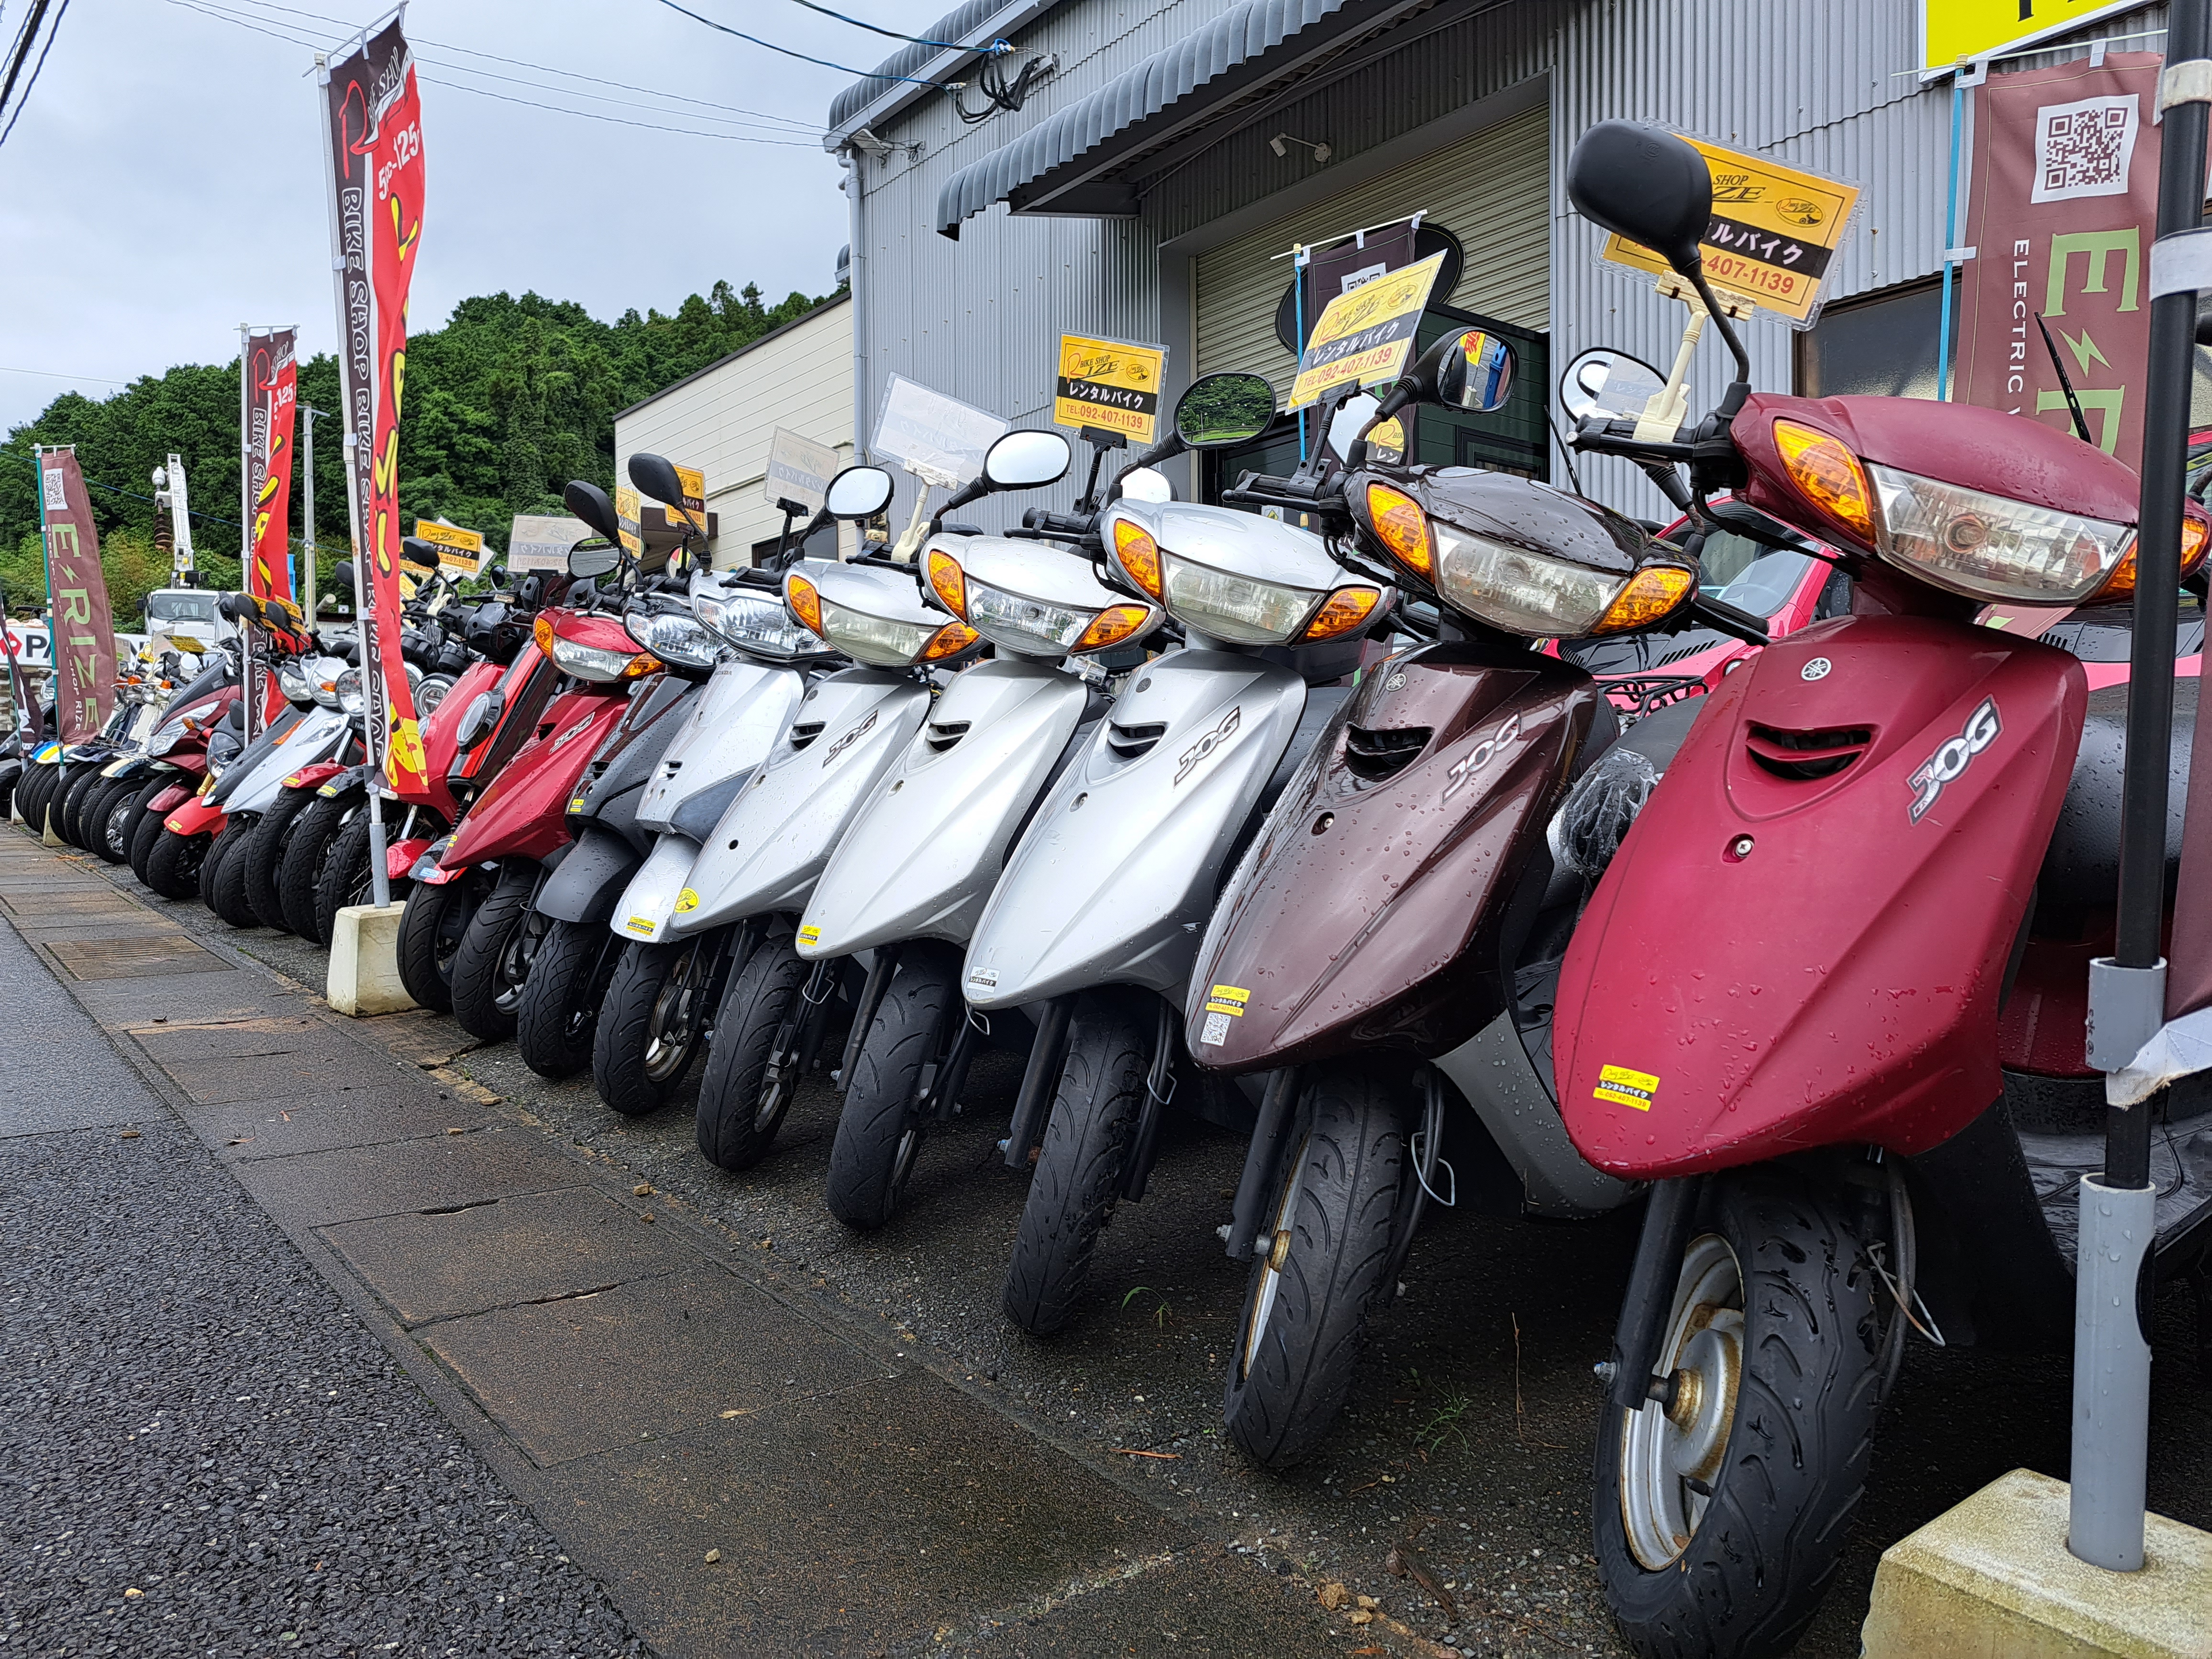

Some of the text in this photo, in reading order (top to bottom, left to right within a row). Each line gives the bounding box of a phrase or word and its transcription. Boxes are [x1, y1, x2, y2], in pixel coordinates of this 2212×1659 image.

[379, 46, 401, 97] SHOP
[1712, 186, 1767, 200] ZE
[1713, 175, 1749, 186] SHOP
[342, 187, 364, 274] BIKE
[1709, 221, 1803, 265] ルバイク
[1702, 255, 1794, 294] -407-1139
[349, 280, 369, 381] SHOP
[2008, 239, 2030, 393] ELECTRIC
[1080, 354, 1111, 368] BIKE SHOP
[1313, 321, 1400, 366] レンタルバイク
[1069, 382, 1144, 409] レンタルバイク
[253, 408, 266, 460] BIKE
[356, 388, 371, 471] BIKE
[431, 542, 473, 558] ンタルバイク
[439, 554, 473, 566] 2-407-1139
[75, 700, 83, 731] RIZE
[548, 711, 596, 755] JOG
[822, 708, 879, 770] JOG
[1173, 705, 1241, 789] JOG
[1440, 707, 1523, 806] JOG
[1906, 694, 2004, 826] JOG
